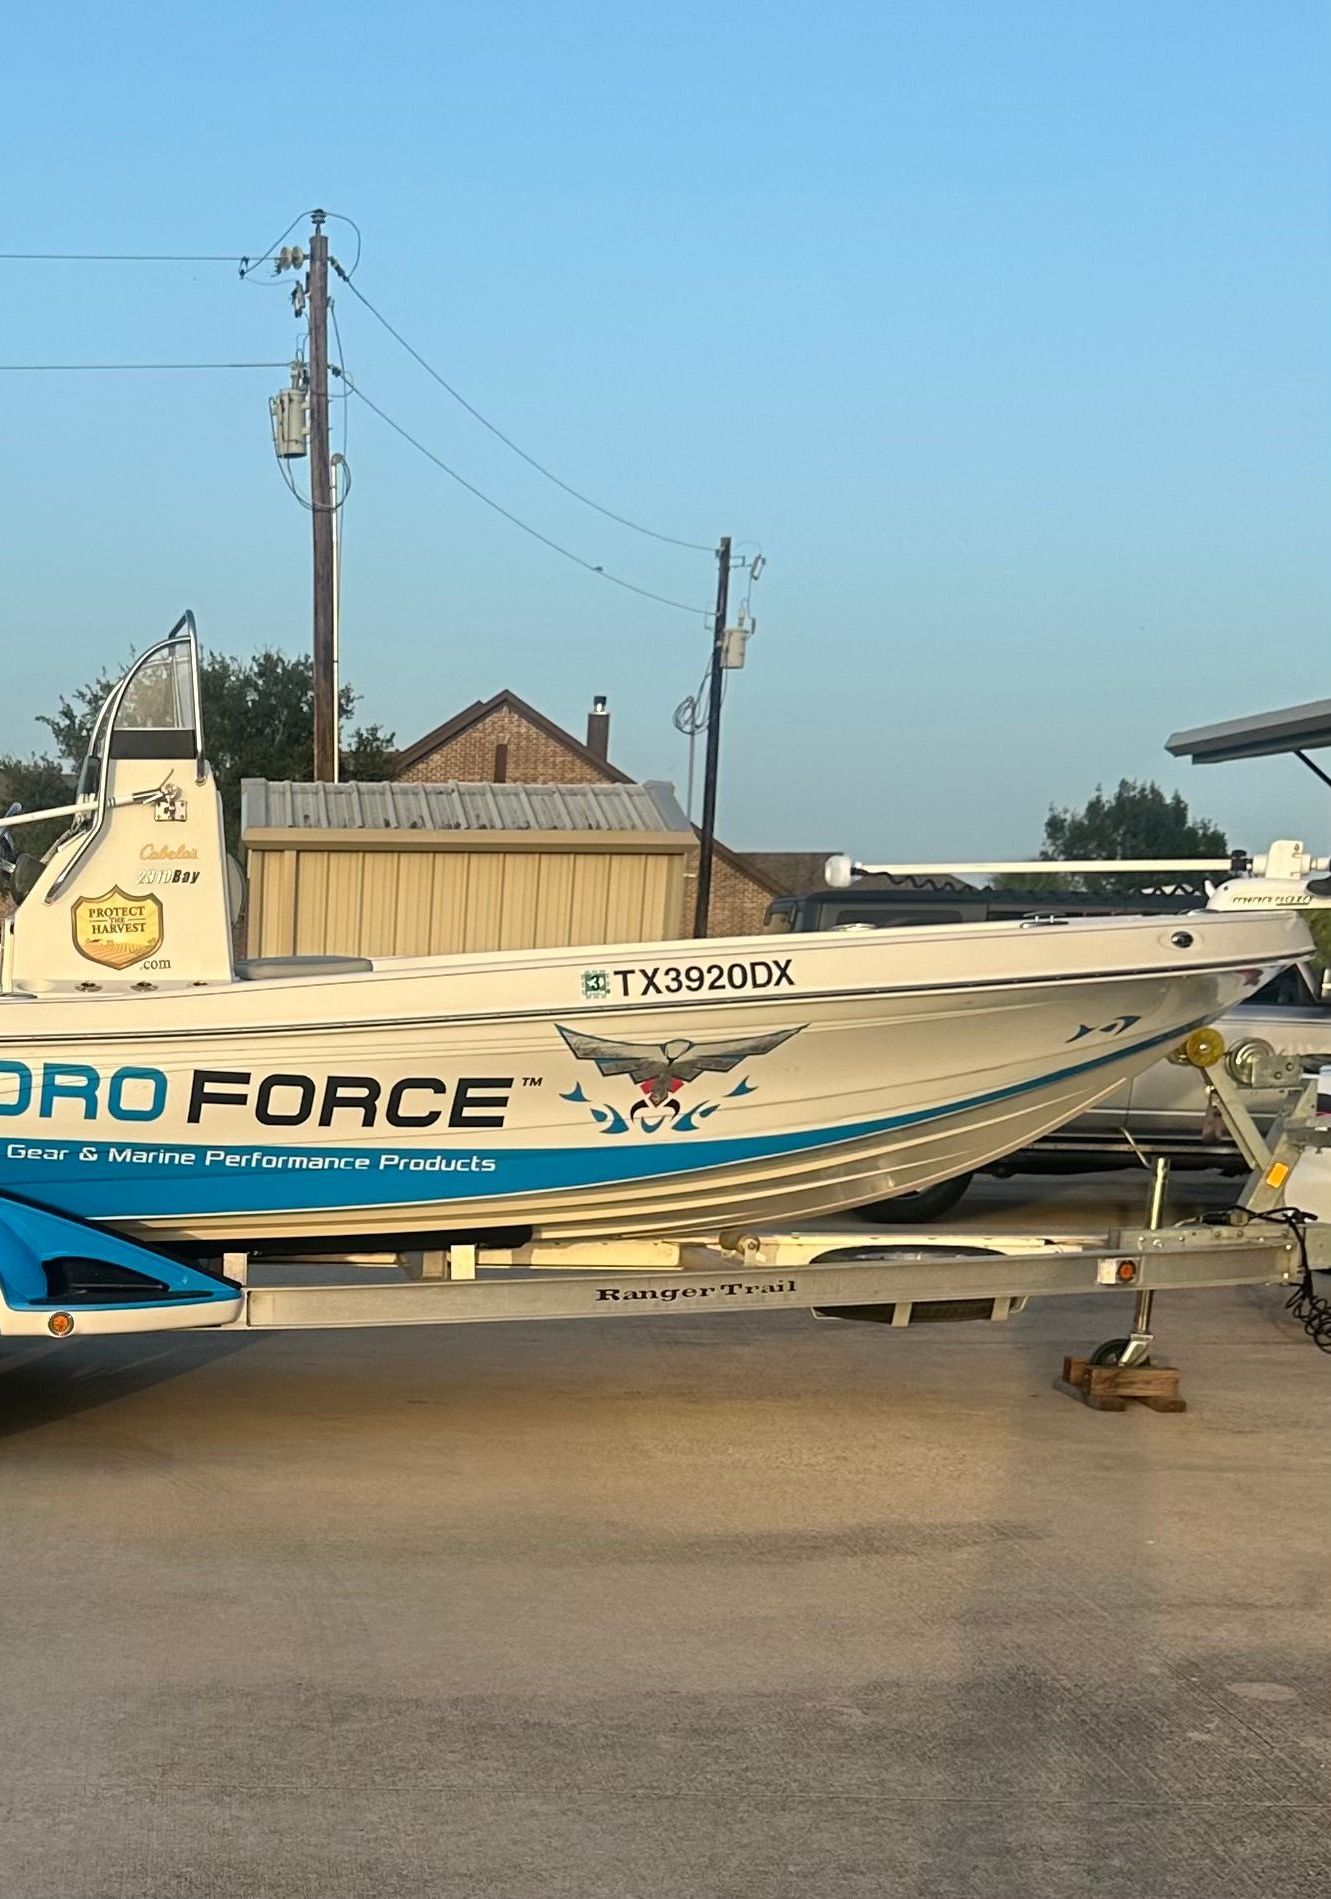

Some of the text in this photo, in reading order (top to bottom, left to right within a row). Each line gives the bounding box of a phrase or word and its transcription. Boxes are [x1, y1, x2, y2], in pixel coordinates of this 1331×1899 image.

[88, 906, 146, 918] PROTECT
[109, 916, 126, 924] THE
[91, 923, 147, 935] HARVEST
[139, 959, 172, 971] .com
[613, 958, 796, 998] TX3920DX
[186, 1069, 515, 1128] FORCE
[6, 1143, 69, 1161] Gear
[79, 1146, 98, 1162] &
[108, 1147, 195, 1166] Marine
[204, 1149, 370, 1170] Performance
[378, 1154, 497, 1173] Products
[595, 1280, 798, 1302] Ranger Trail
